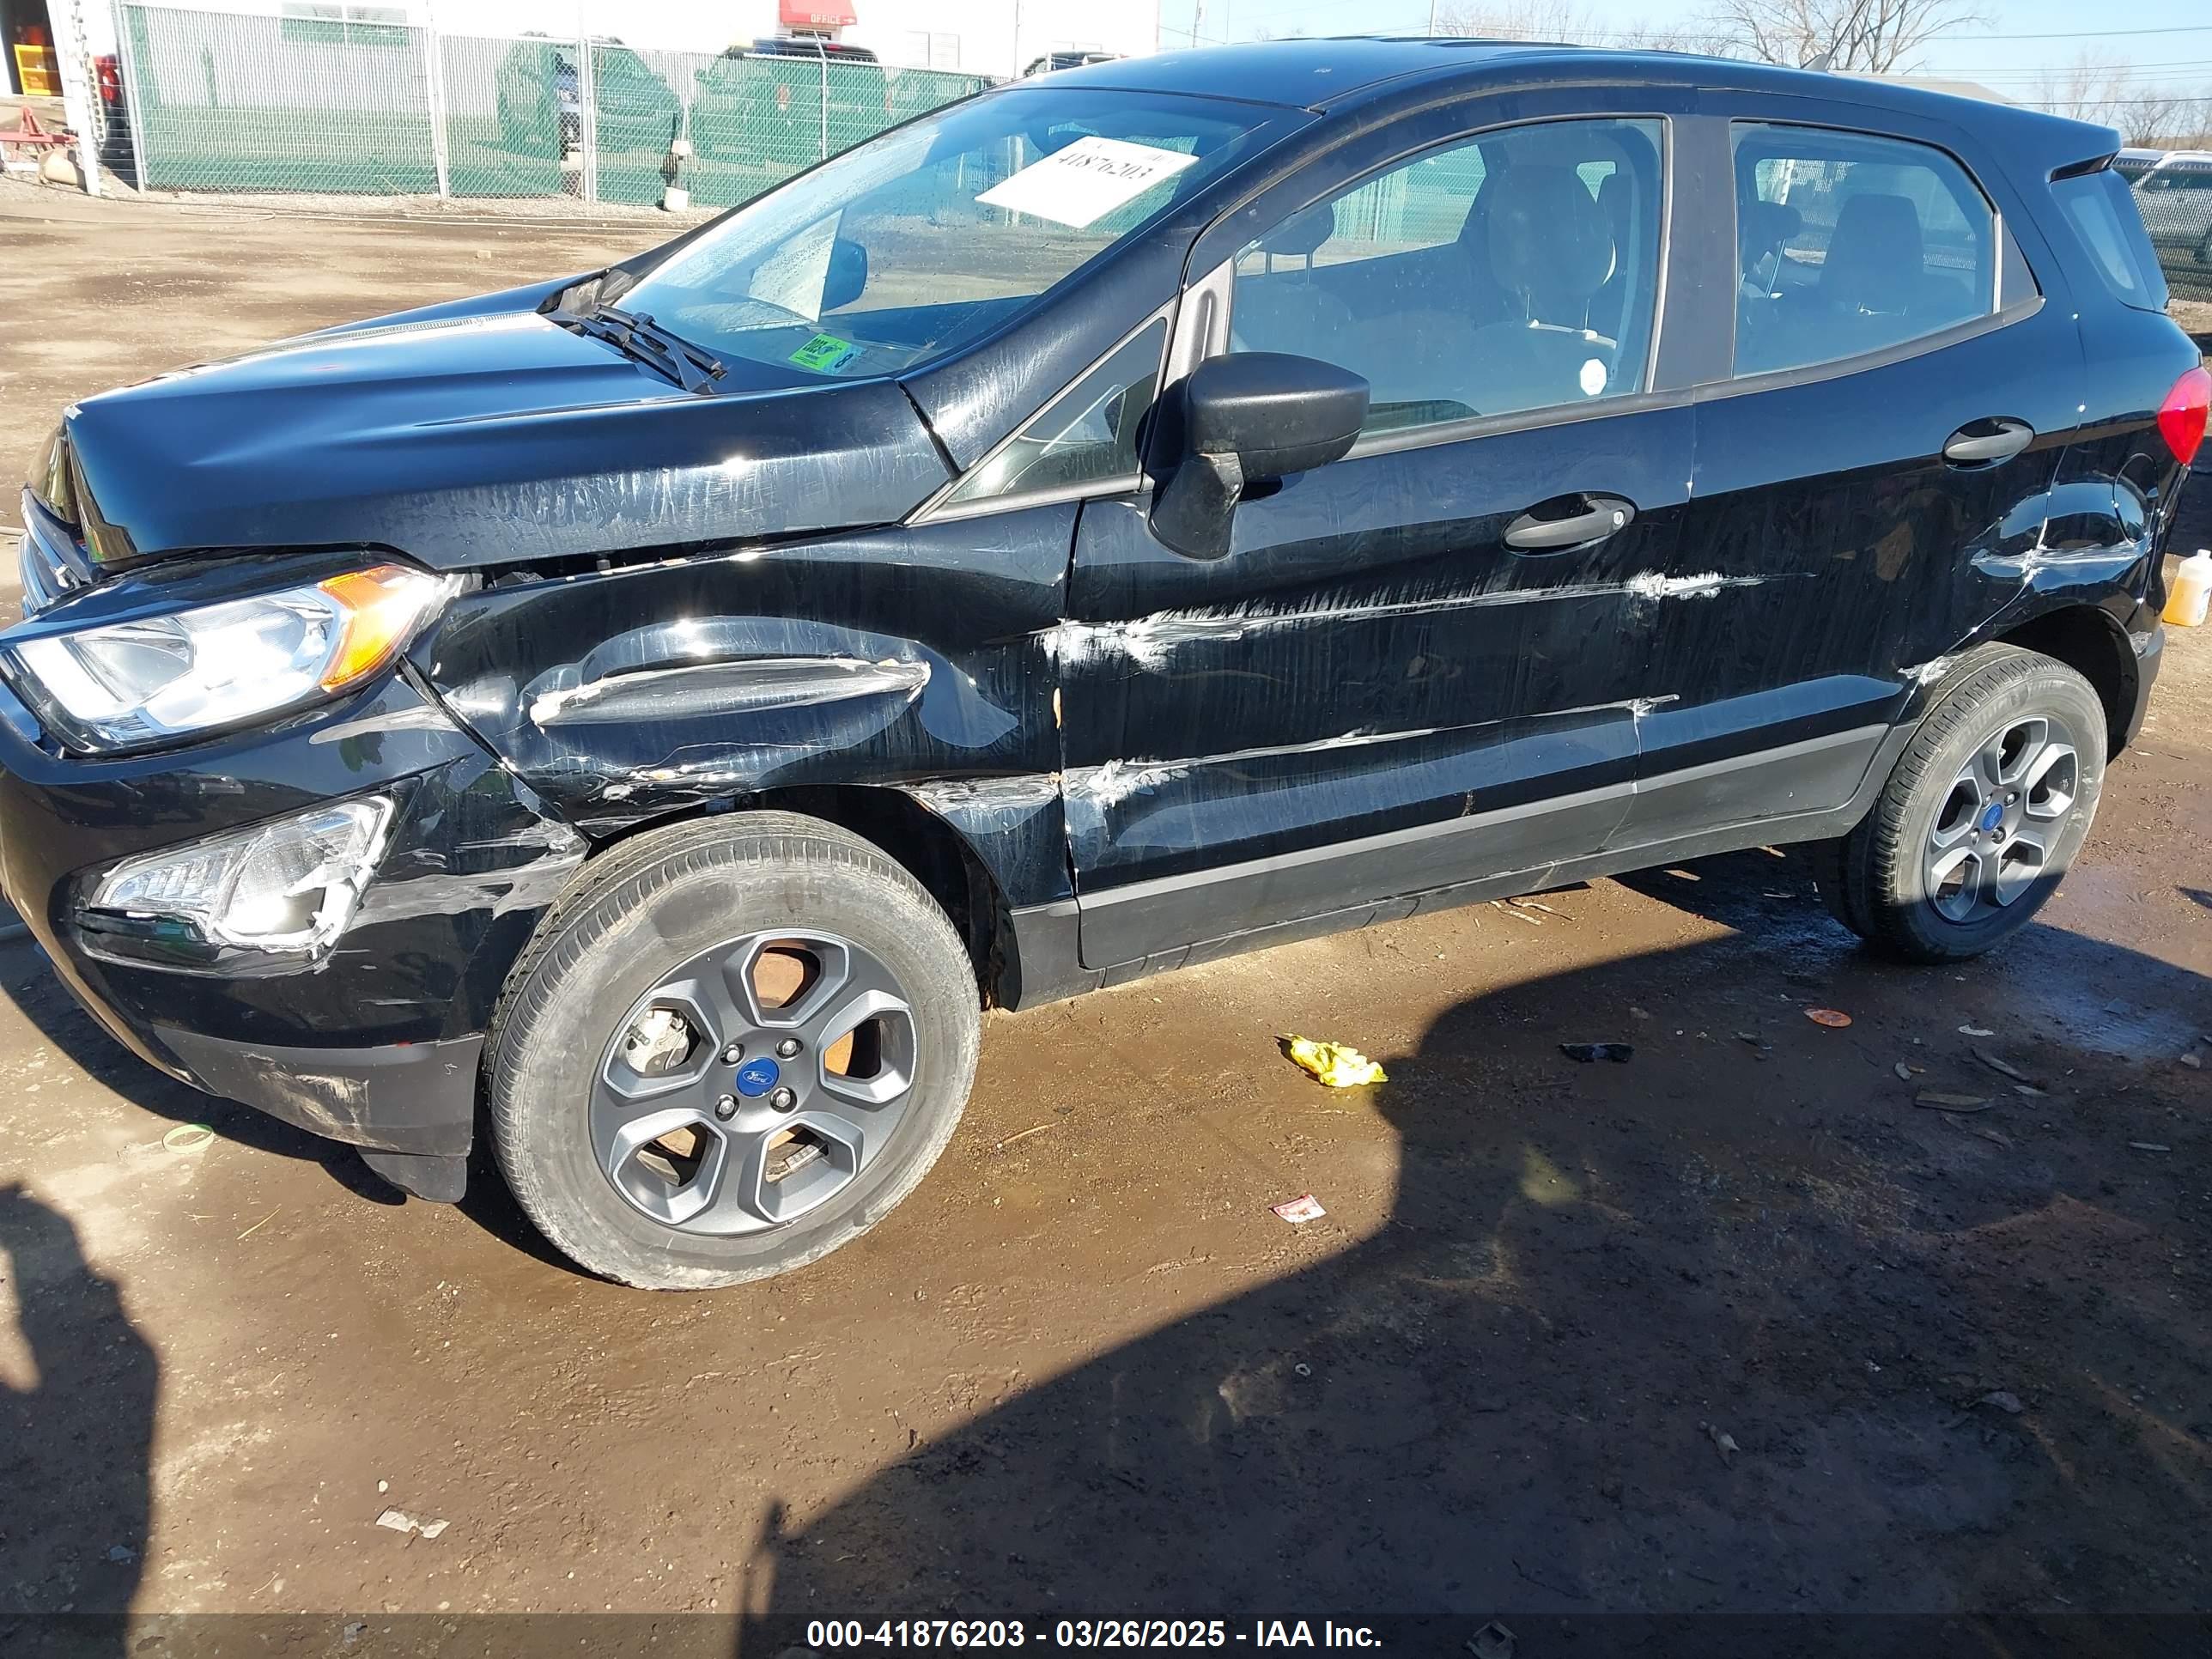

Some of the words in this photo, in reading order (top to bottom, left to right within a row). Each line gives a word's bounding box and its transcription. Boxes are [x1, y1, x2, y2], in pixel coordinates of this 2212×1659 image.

[810, 14, 840, 24] OFFICE
[1058, 153, 1153, 179] 41876203
[746, 1072, 769, 1083] Ford
